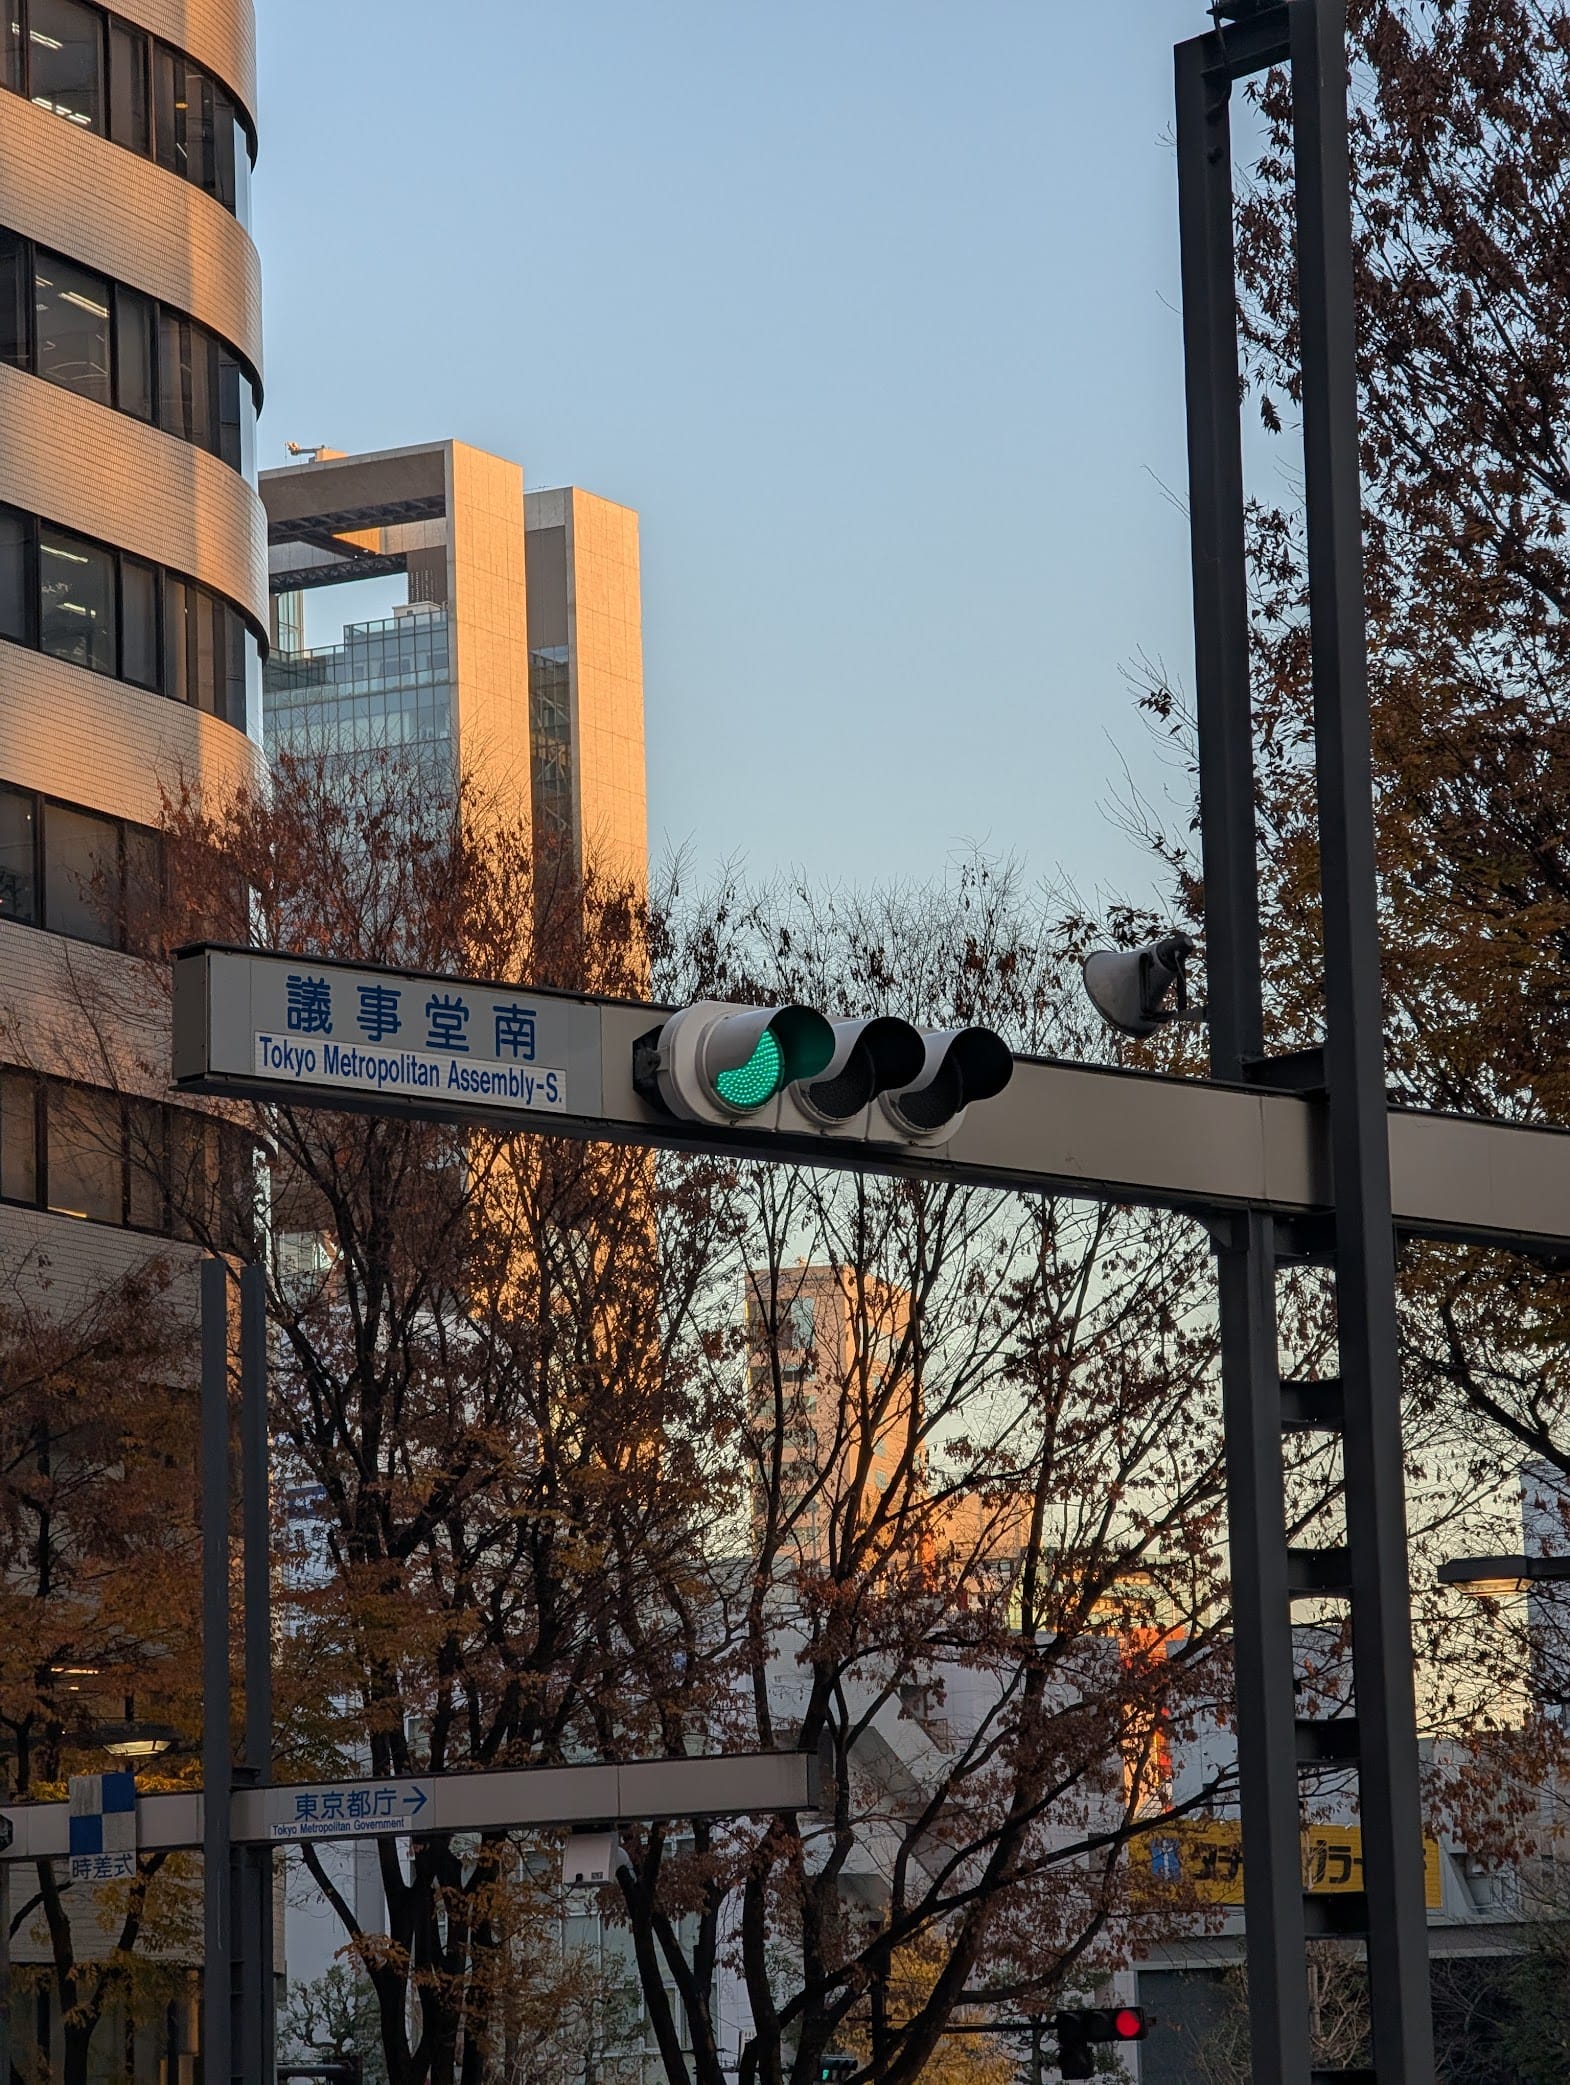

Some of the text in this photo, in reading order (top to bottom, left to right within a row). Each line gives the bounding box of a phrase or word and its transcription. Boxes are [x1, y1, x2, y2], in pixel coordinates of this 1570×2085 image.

[285, 974, 537, 1062] 議事堂南
[258, 1035, 563, 1106] Tokyo Metropolitan Assembly-S.
[294, 1787, 397, 1822] 東京都庁
[272, 1817, 405, 1837] Tokyo Metropolitan Government
[72, 1852, 134, 1880] 時差式
